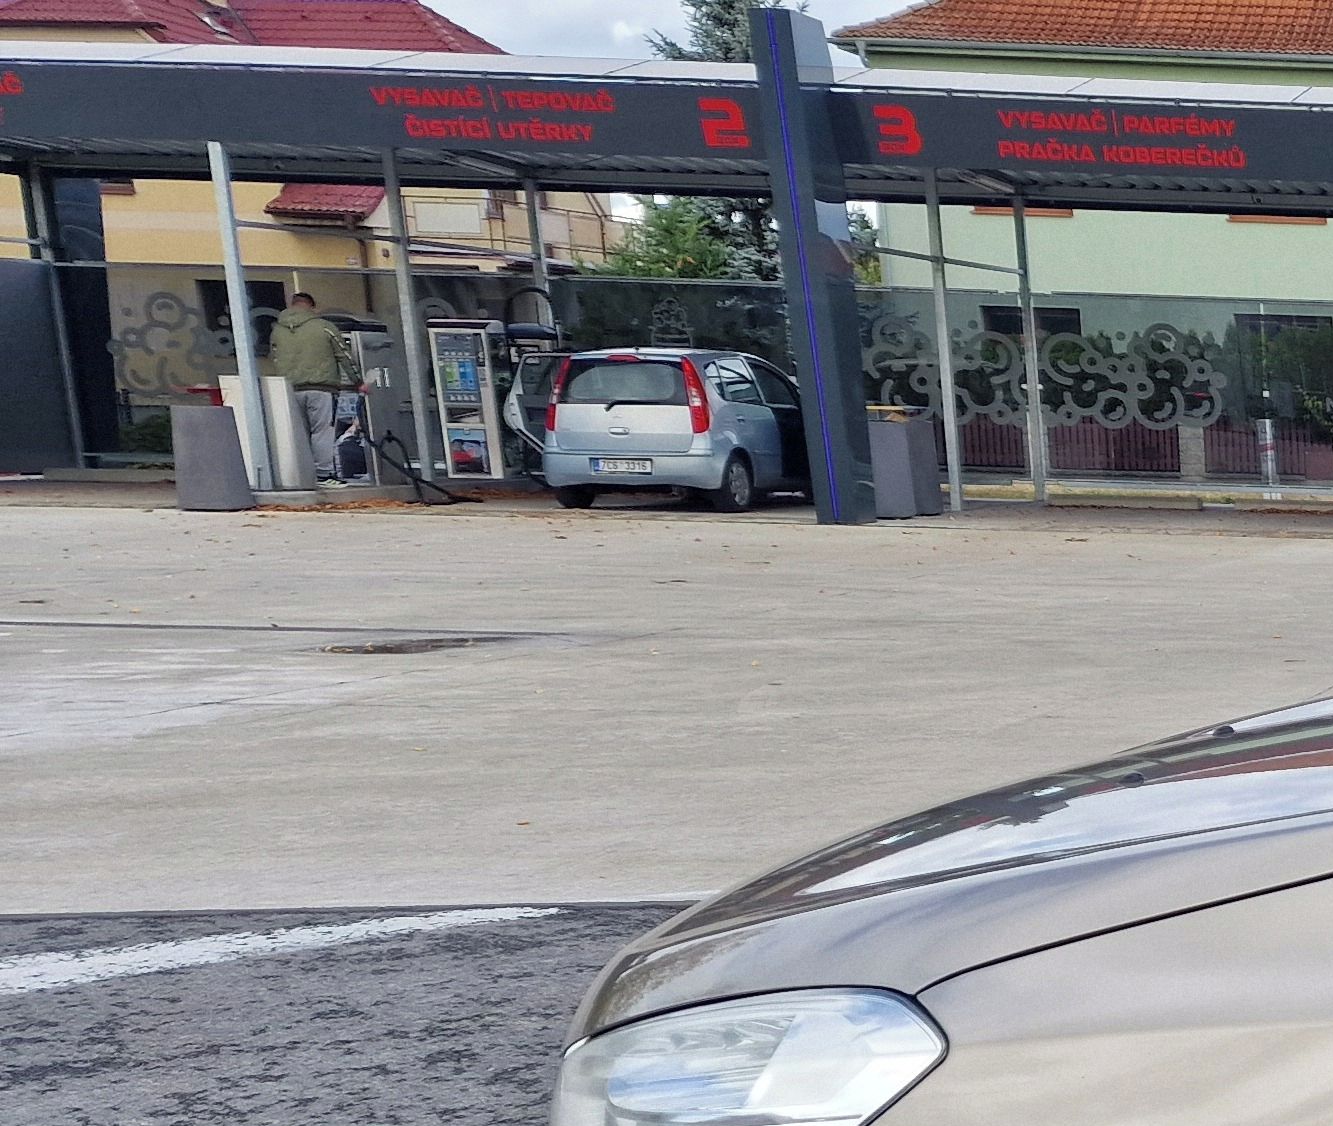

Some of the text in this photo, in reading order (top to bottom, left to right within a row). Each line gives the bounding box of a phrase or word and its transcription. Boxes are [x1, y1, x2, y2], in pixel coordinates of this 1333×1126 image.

[370, 85, 616, 112] VYSAVAČ TEPOVAČ
[404, 113, 593, 142] ČISTÍCÍ UTĚRKY
[698, 97, 751, 148] 2
[873, 105, 923, 155] 3
[998, 110, 1236, 137] VYSAVAČ PARFÉMY
[998, 138, 1247, 169] PRAČKA KOBEREČKŮ
